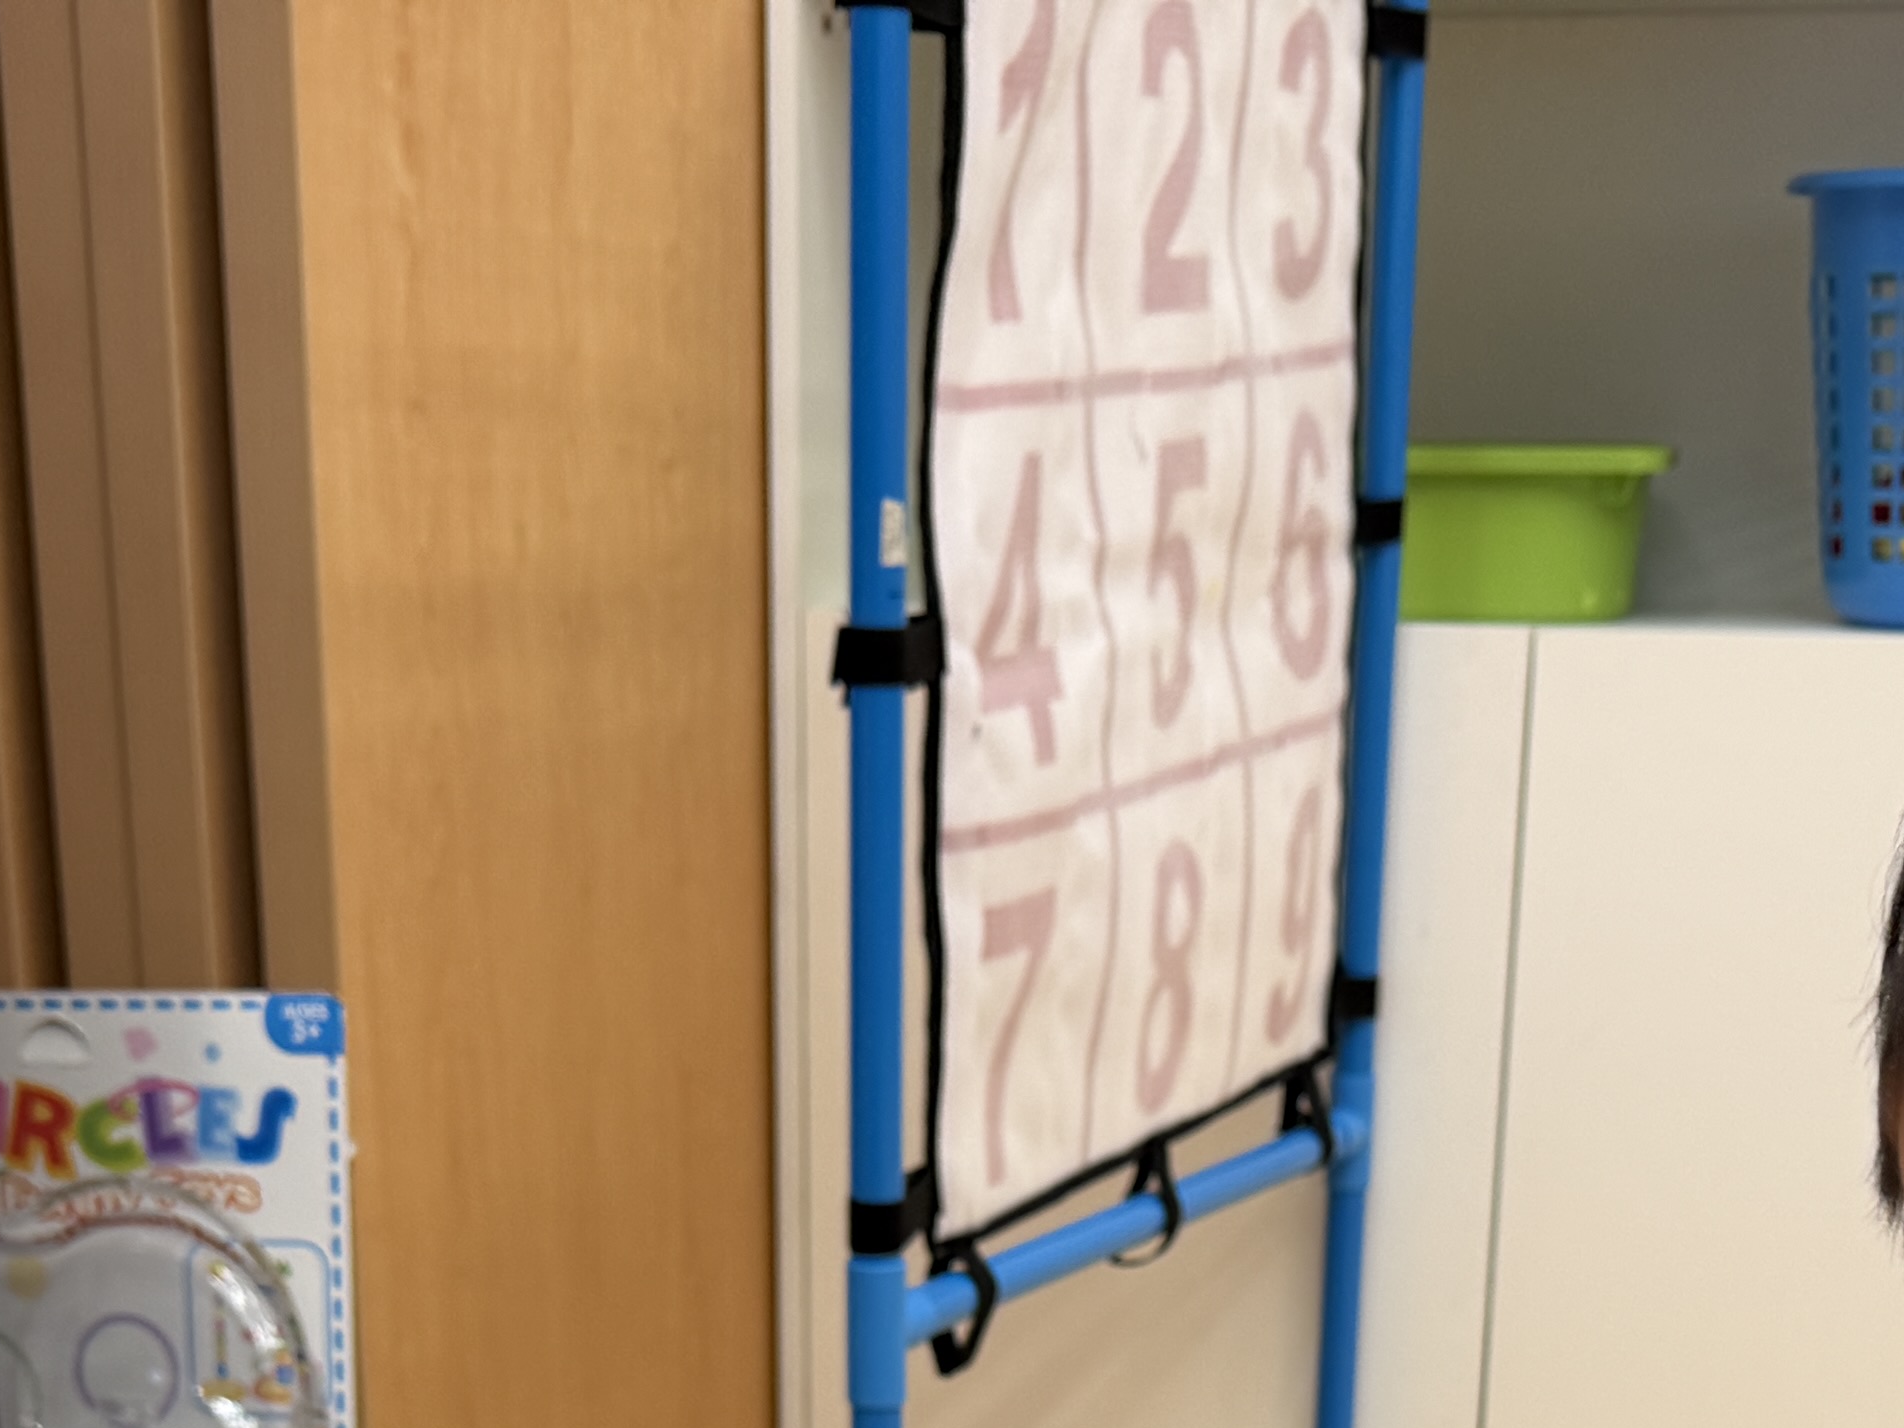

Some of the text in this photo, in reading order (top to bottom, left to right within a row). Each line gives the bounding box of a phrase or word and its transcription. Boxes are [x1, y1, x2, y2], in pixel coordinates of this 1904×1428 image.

[1139, 0, 1212, 313] 2
[1273, 12, 1331, 303] 3
[977, 409, 1327, 767] 4 5 6
[981, 789, 1321, 1188] 7 8 9
